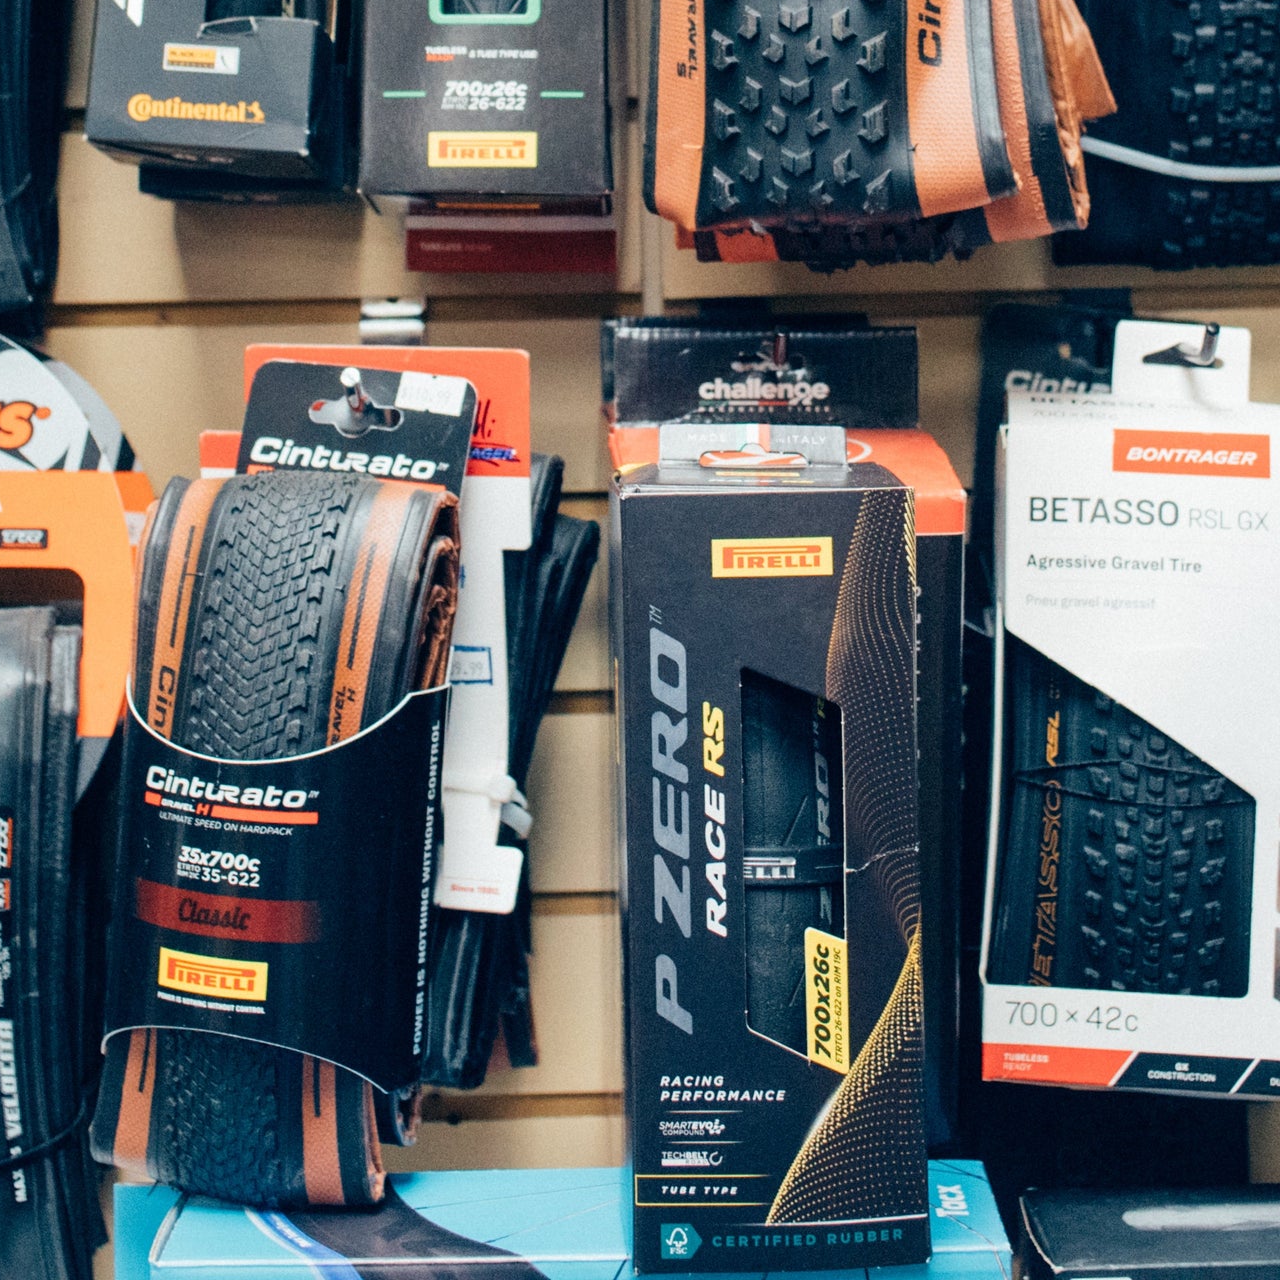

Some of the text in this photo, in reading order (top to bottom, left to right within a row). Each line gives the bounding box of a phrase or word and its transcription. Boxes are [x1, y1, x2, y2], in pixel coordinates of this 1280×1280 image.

[444, 80, 529, 98] 700x26c
[127, 93, 247, 124] Continental
[468, 96, 528, 112] 26-622
[438, 139, 527, 160] PIRELLI
[697, 376, 830, 405] challenge
[249, 435, 438, 480] Cinturato
[1126, 446, 1258, 466] BONTRAGER
[1028, 495, 1270, 532] BETASSO RSL GX
[722, 544, 822, 569] PIRELLI
[1026, 553, 1203, 574] Agressive Gravel Tire
[1045, 711, 1061, 768] RSL
[145, 764, 308, 810] Cinturato
[161, 798, 210, 816] GRAVEL H
[703, 700, 729, 938] RACE RS
[159, 811, 293, 837] ULTIMATE SPEED ON HARDPACK
[649, 627, 694, 1035] P ZERO
[178, 845, 261, 873] 35x700c
[201, 866, 261, 888] 35-622
[411, 719, 441, 1056] POWER NOTHING WITHOUT CONTROL
[177, 896, 251, 931] Classic
[167, 956, 257, 993] PIRELLI
[813, 943, 833, 1060] 700x26c
[1005, 1000, 1139, 1033] 700 42c
[1003, 1052, 1050, 1063] TUBELESS
[1174, 1062, 1189, 1072] GX
[660, 1075, 725, 1088] RACING
[1147, 1070, 1216, 1083] CONSTRUCTION
[660, 1089, 787, 1102] PERFORMANCE
[661, 1151, 709, 1161] TECHBELT
[661, 1184, 739, 1196] TUBE TYPE
[936, 1183, 970, 1218] Tacx
[711, 1227, 904, 1248] CERTIFIED RUBBER
[669, 1245, 688, 1256] FSC
